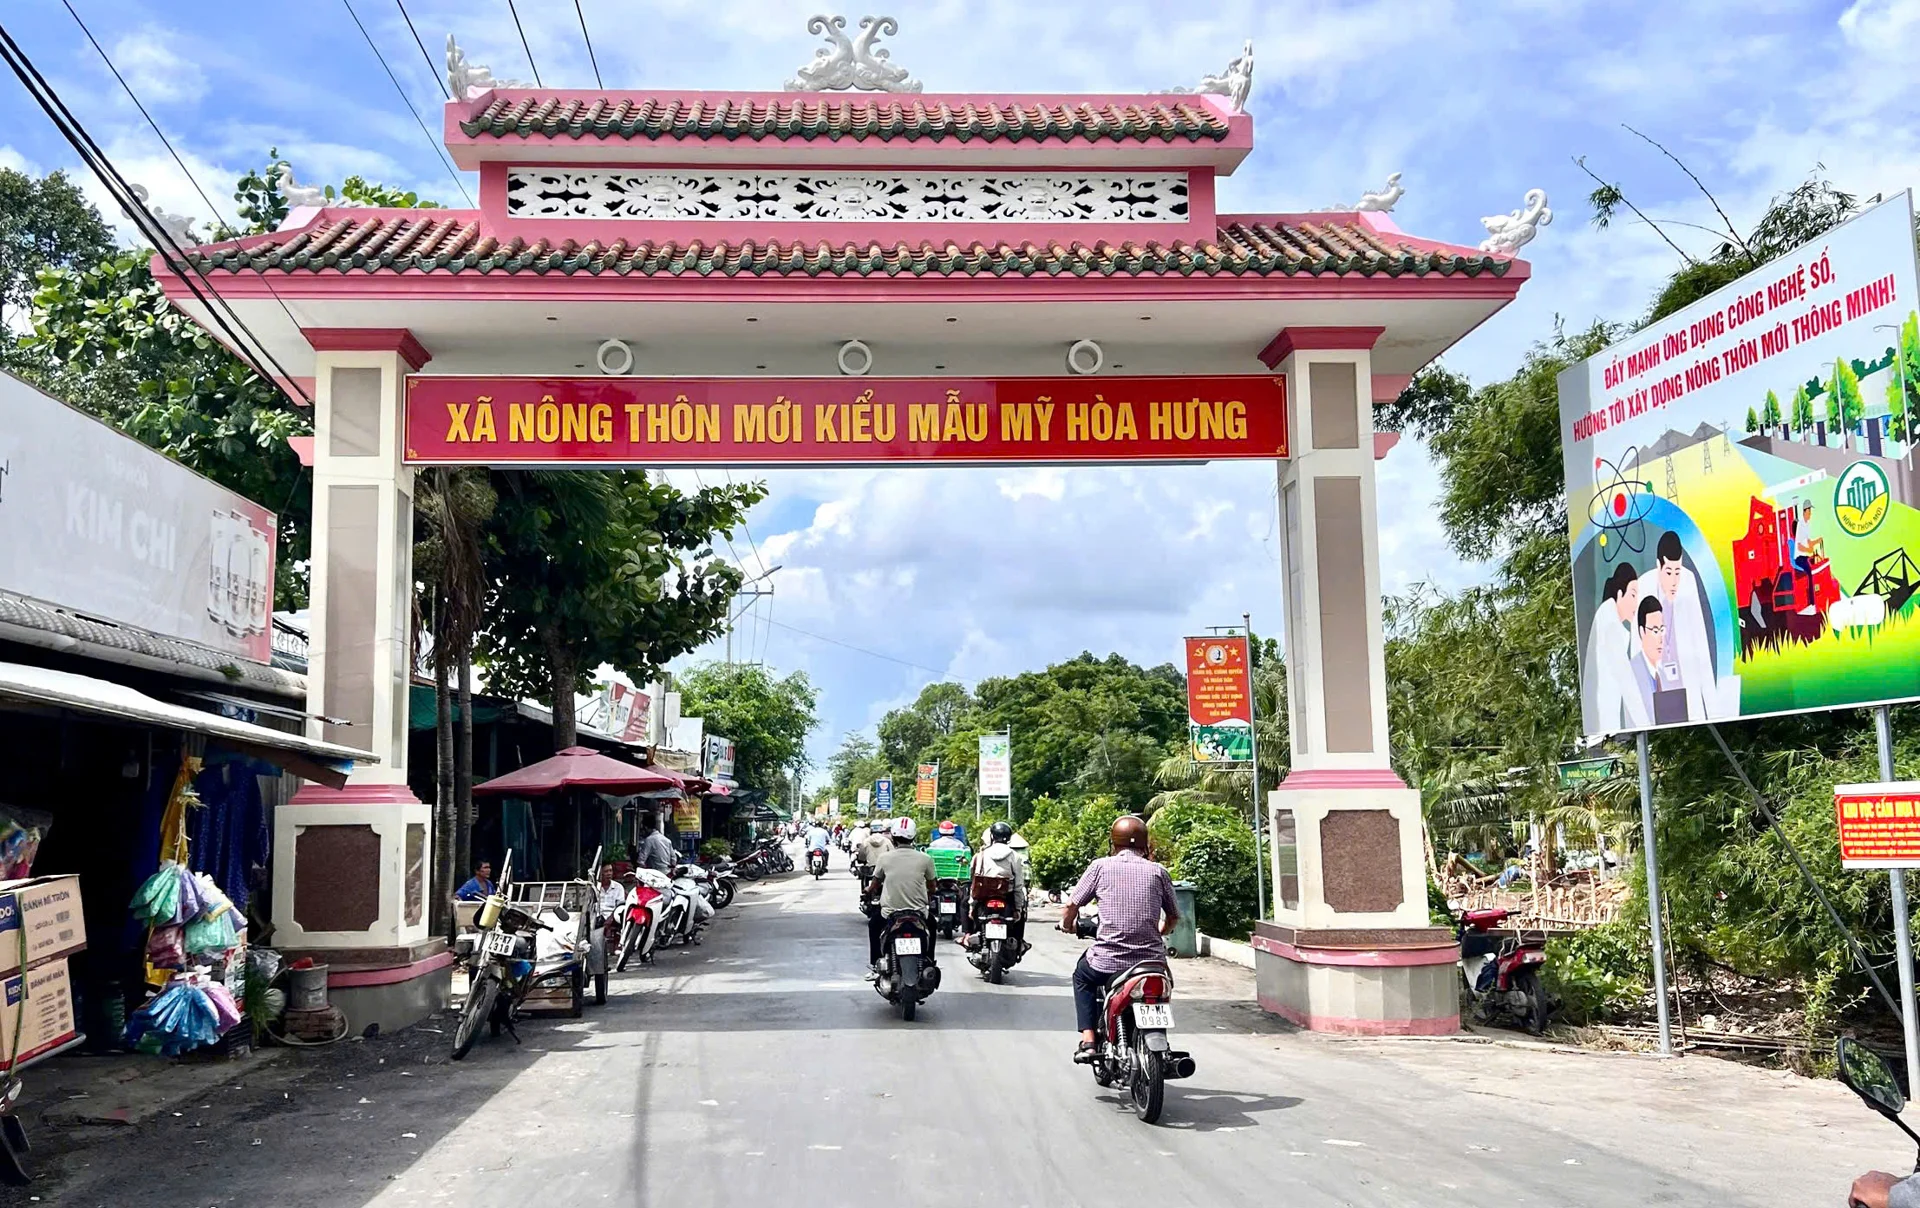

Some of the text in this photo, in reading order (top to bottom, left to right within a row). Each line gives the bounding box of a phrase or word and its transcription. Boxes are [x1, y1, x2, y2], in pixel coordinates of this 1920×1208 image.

[1573, 274, 1896, 442] HƯỚNG TỚI XÂY DỰNG NÔNG THÔN MỚI THÔNG MINH!
[1604, 247, 1836, 390] ĐẨY MẠNH ỨNG DỤNG CÔNG NGHỆ SỐ,
[446, 388, 1247, 443] XÃ NÔNG THÔN MỚI KIỂU MẪU MỸ HÒA HƯNG
[66, 480, 176, 571] KIM CHI
